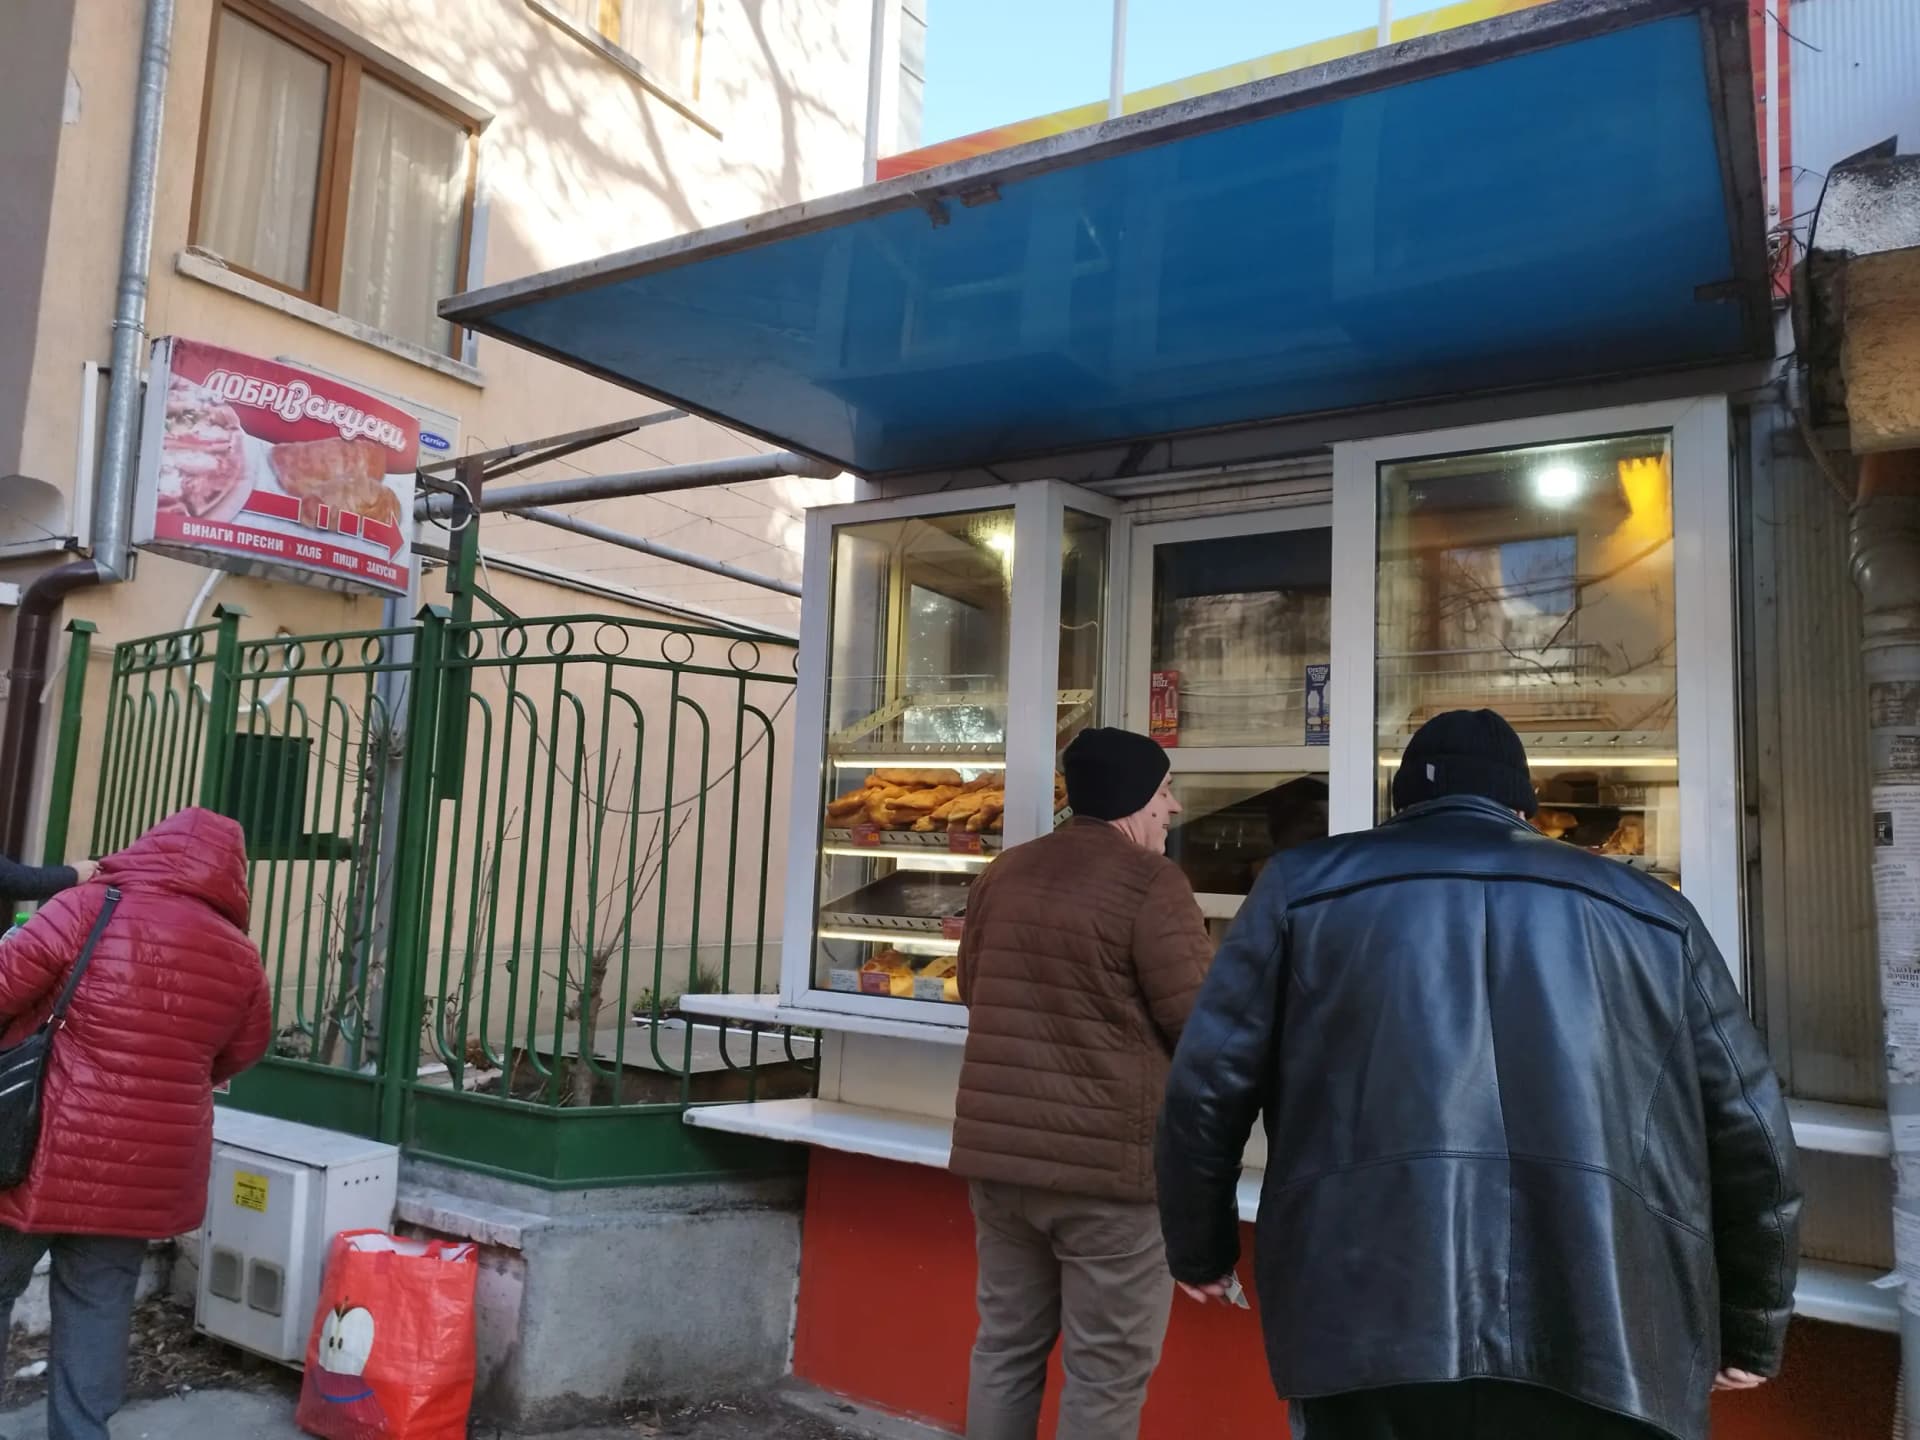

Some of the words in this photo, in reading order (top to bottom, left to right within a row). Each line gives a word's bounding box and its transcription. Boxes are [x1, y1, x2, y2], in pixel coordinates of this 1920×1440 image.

[420, 434, 447, 447] Carrier
[182, 522, 234, 543] ВИНАГИ
[237, 531, 285, 552] ПРЕСНИ
[296, 543, 323, 560] ХЛЯБ
[332, 551, 359, 568] ПИЦИ
[366, 561, 398, 580] ЗАКУСКИ
